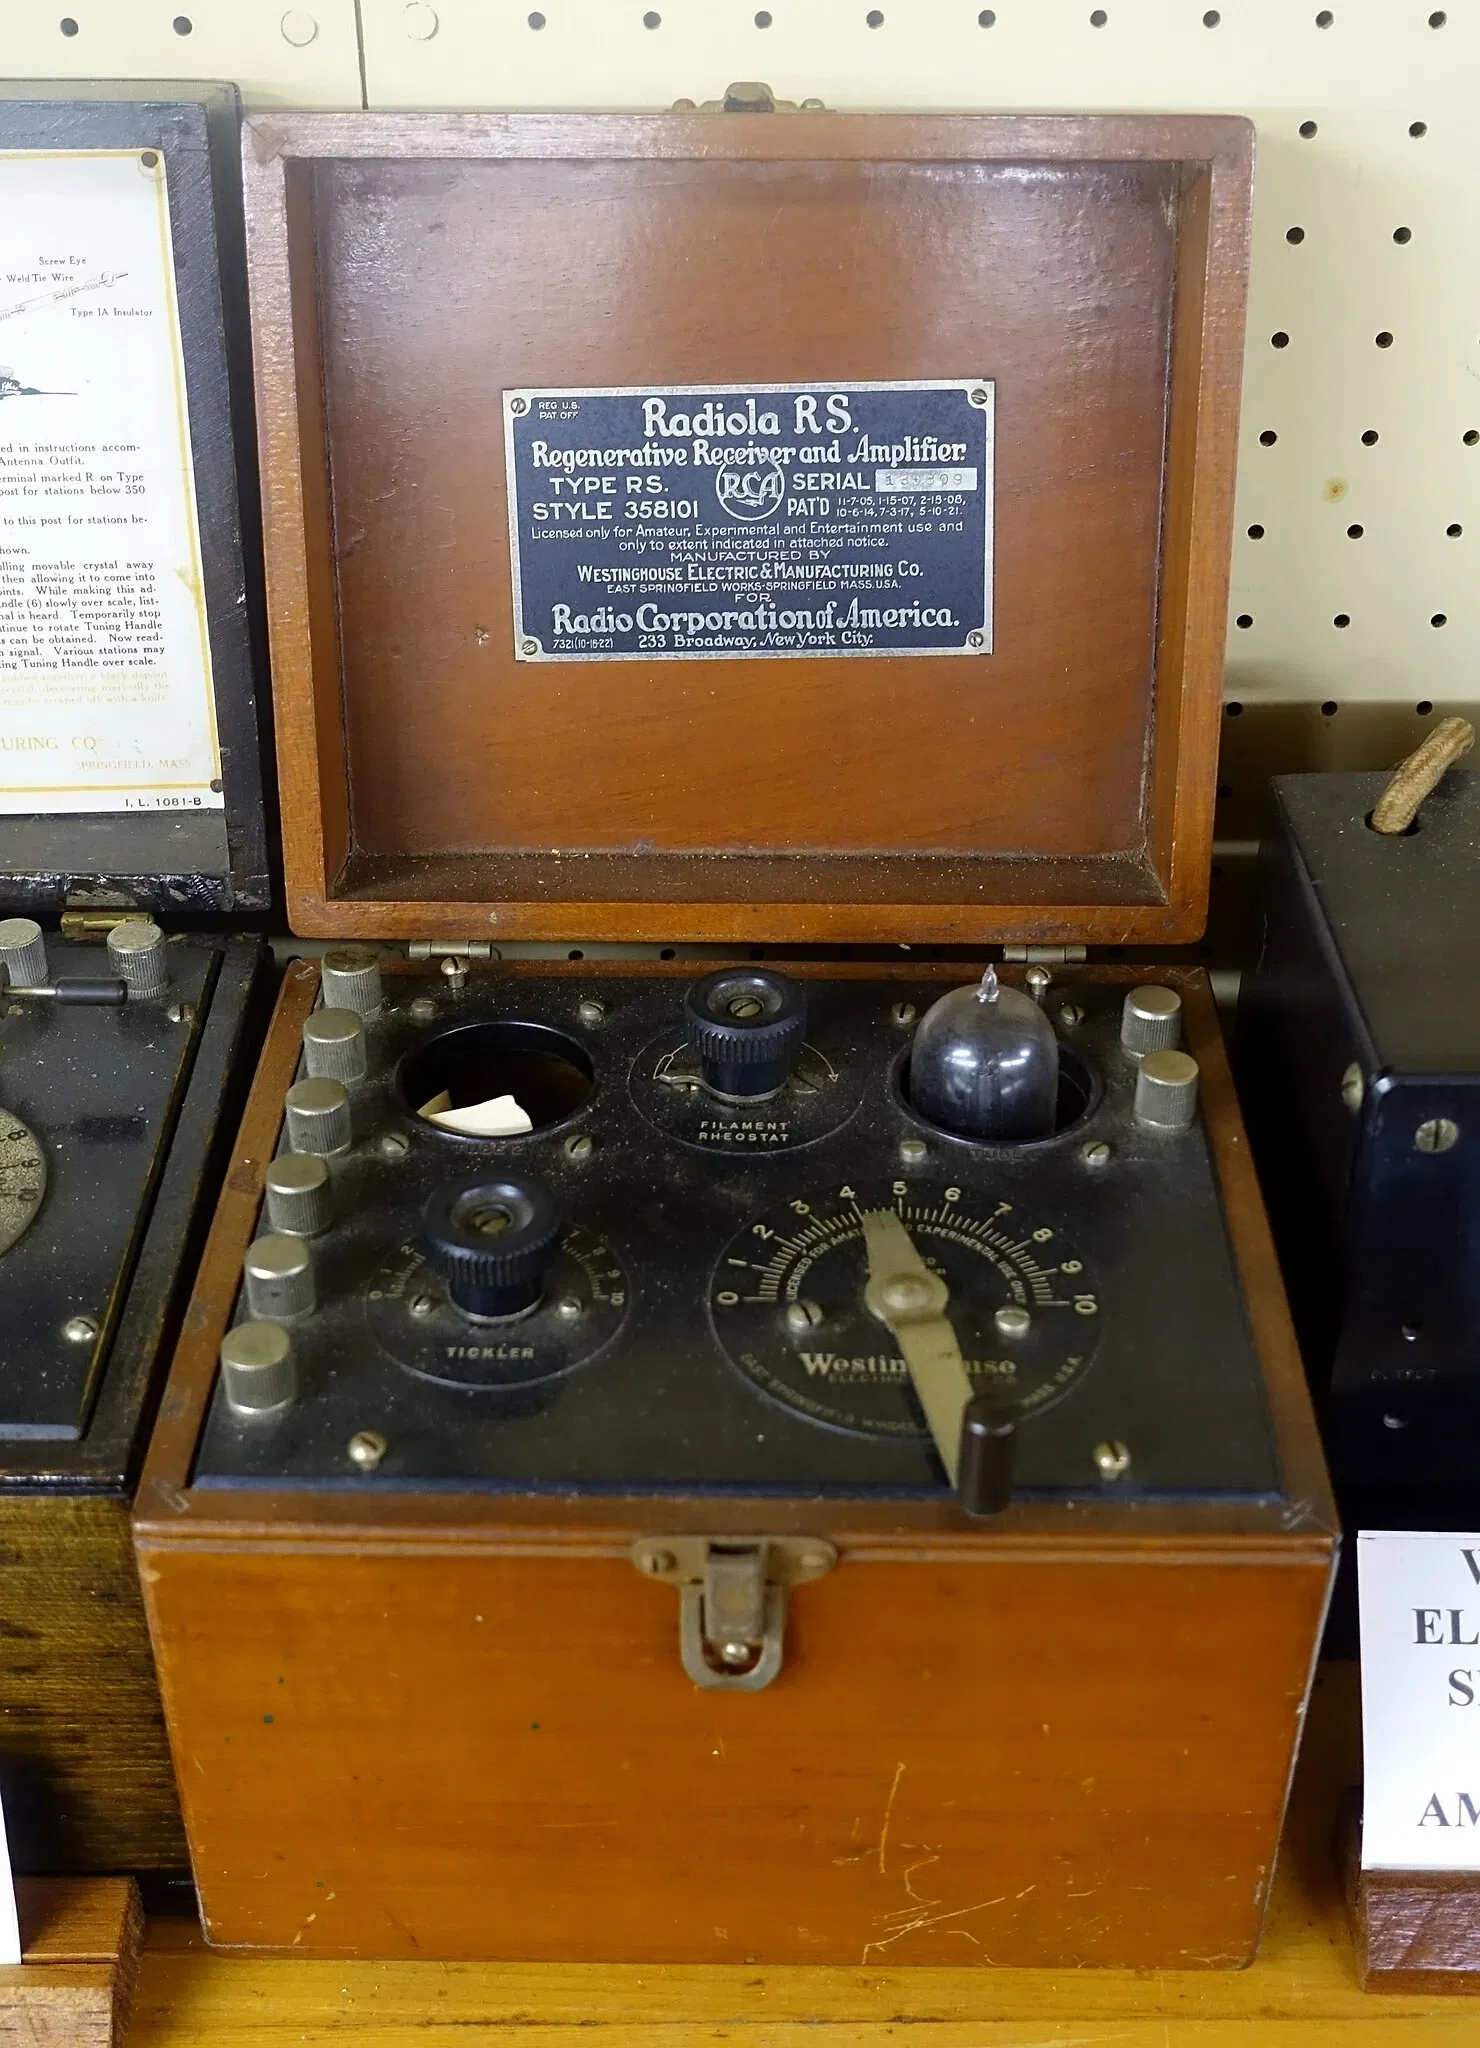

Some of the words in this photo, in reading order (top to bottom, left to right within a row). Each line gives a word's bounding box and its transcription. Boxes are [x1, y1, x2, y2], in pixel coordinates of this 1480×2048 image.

[38, 256, 66, 265] Screw
[69, 256, 87, 266] Eye
[6, 274, 30, 283] Weld
[31, 273, 47, 282] Tie
[51, 273, 74, 282] Wire
[70, 308, 93, 318] Type
[113, 307, 153, 317] Insulator
[562, 401, 581, 410] U.S.
[641, 396, 781, 438] Radiola
[19, 443, 29, 453] in
[34, 442, 96, 453] instructions
[102, 443, 141, 452] accom-
[531, 440, 688, 474] Regenerative
[692, 438, 796, 466] Receiver
[799, 439, 842, 464] and
[847, 433, 967, 468] Amplifier.
[49, 455, 85, 466] Outfit.
[41, 472, 81, 483] marked
[85, 472, 94, 482] R
[100, 474, 113, 482] on
[116, 472, 145, 484] Type
[792, 472, 871, 491] SERIAL
[23, 486, 39, 496] for
[44, 486, 85, 495] stations
[90, 485, 121, 495] below
[125, 484, 146, 495] 350
[549, 476, 617, 495] TYPE
[626, 475, 670, 494] RS.
[721, 471, 782, 507] RCA
[532, 501, 613, 521] STYLE
[624, 500, 699, 520] 358101
[787, 497, 830, 517] PAT'D
[838, 496, 876, 507] 11-7-05,
[878, 495, 917, 506] 1-15-07,
[920, 494, 967, 506] 2-18-08,
[836, 507, 878, 518] 10-6-14,
[879, 507, 915, 517] 7-3-17,
[919, 506, 963, 516] 5-10-21.
[3, 517, 15, 526] to
[18, 515, 37, 525] this
[40, 516, 62, 527] post
[68, 514, 83, 525] for
[87, 515, 128, 525] stations
[131, 514, 148, 524] be-
[531, 526, 583, 539] Licensed
[585, 526, 610, 541] only
[613, 525, 633, 538] for
[635, 525, 691, 538] Amateur,
[695, 522, 780, 538] Experimental
[783, 522, 806, 535] and
[810, 521, 903, 534] Entertainment
[908, 522, 933, 533] use
[938, 521, 963, 532] and
[619, 538, 646, 554] only
[649, 539, 664, 551] to
[668, 539, 708, 550] extent
[711, 537, 770, 550] indicated
[774, 537, 785, 549] in
[789, 536, 844, 549] attached
[847, 536, 889, 548] notice.
[670, 551, 802, 562] MANUFACTURED
[809, 550, 831, 560] BY
[31, 561, 76, 571] movable
[83, 560, 118, 572] crystal
[126, 561, 154, 571] away
[2, 574, 25, 584] then
[30, 573, 75, 585] allowing
[78, 573, 87, 583] it
[89, 574, 100, 582] to
[104, 574, 131, 582] come
[134, 572, 156, 582] into
[36, 585, 68, 596] While
[73, 585, 112, 596] making
[116, 585, 135, 595] this
[140, 583, 157, 594] ad-
[607, 584, 636, 594] EAST
[639, 582, 718, 594] SPRINGFIELD
[26, 598, 42, 609] (6)
[45, 597, 77, 609] slowly
[81, 599, 103, 607] over
[107, 596, 136, 608] scale,
[735, 593, 772, 603] FOR
[17, 611, 26, 620] is
[69, 608, 135, 621] Temporarily
[138, 608, 161, 619] stop
[551, 603, 634, 635] Radio
[636, 601, 815, 636] Corporation
[816, 601, 838, 630] of
[835, 597, 961, 629] America.
[32, 623, 44, 632] to
[48, 622, 80, 632] rotate
[84, 621, 121, 632] Tuning
[124, 620, 163, 631] Handle
[9, 637, 28, 645] can
[32, 634, 45, 644] be
[48, 634, 97, 644] obtained.
[108, 633, 133, 642] Now
[136, 632, 164, 642] read-
[638, 634, 667, 649] 233
[674, 634, 757, 650] Broadway,
[760, 632, 798, 647] New
[796, 631, 837, 648] York
[841, 631, 874, 646] City.
[9, 647, 43, 658] signal.
[54, 646, 94, 656] Various
[98, 644, 138, 655] stations
[143, 646, 165, 655] may
[21, 658, 58, 669] Tuning
[61, 657, 99, 668] Handle
[102, 659, 125, 667] over
[128, 656, 157, 666] scale.
[156, 797, 202, 807] 1081-B
[700, 1121, 789, 1131] FILAMENT
[698, 1132, 790, 1142] RHEOSTAT
[831, 1228, 863, 1247] AMAT
[917, 1223, 999, 1261] EXPERIMENTAL
[716, 1290, 739, 1305] 0
[752, 1224, 774, 1241] 2
[790, 1199, 810, 1215] 3
[839, 1185, 856, 1200] 4
[892, 1181, 907, 1196] 5
[945, 1187, 962, 1202] 6
[993, 1202, 1013, 1217] 7
[1032, 1227, 1053, 1243] 8
[1060, 1259, 1083, 1275] 9
[1074, 1293, 1098, 1317] 10
[446, 1346, 534, 1360] TICKLER
[799, 1352, 1017, 1378] Westinuse
